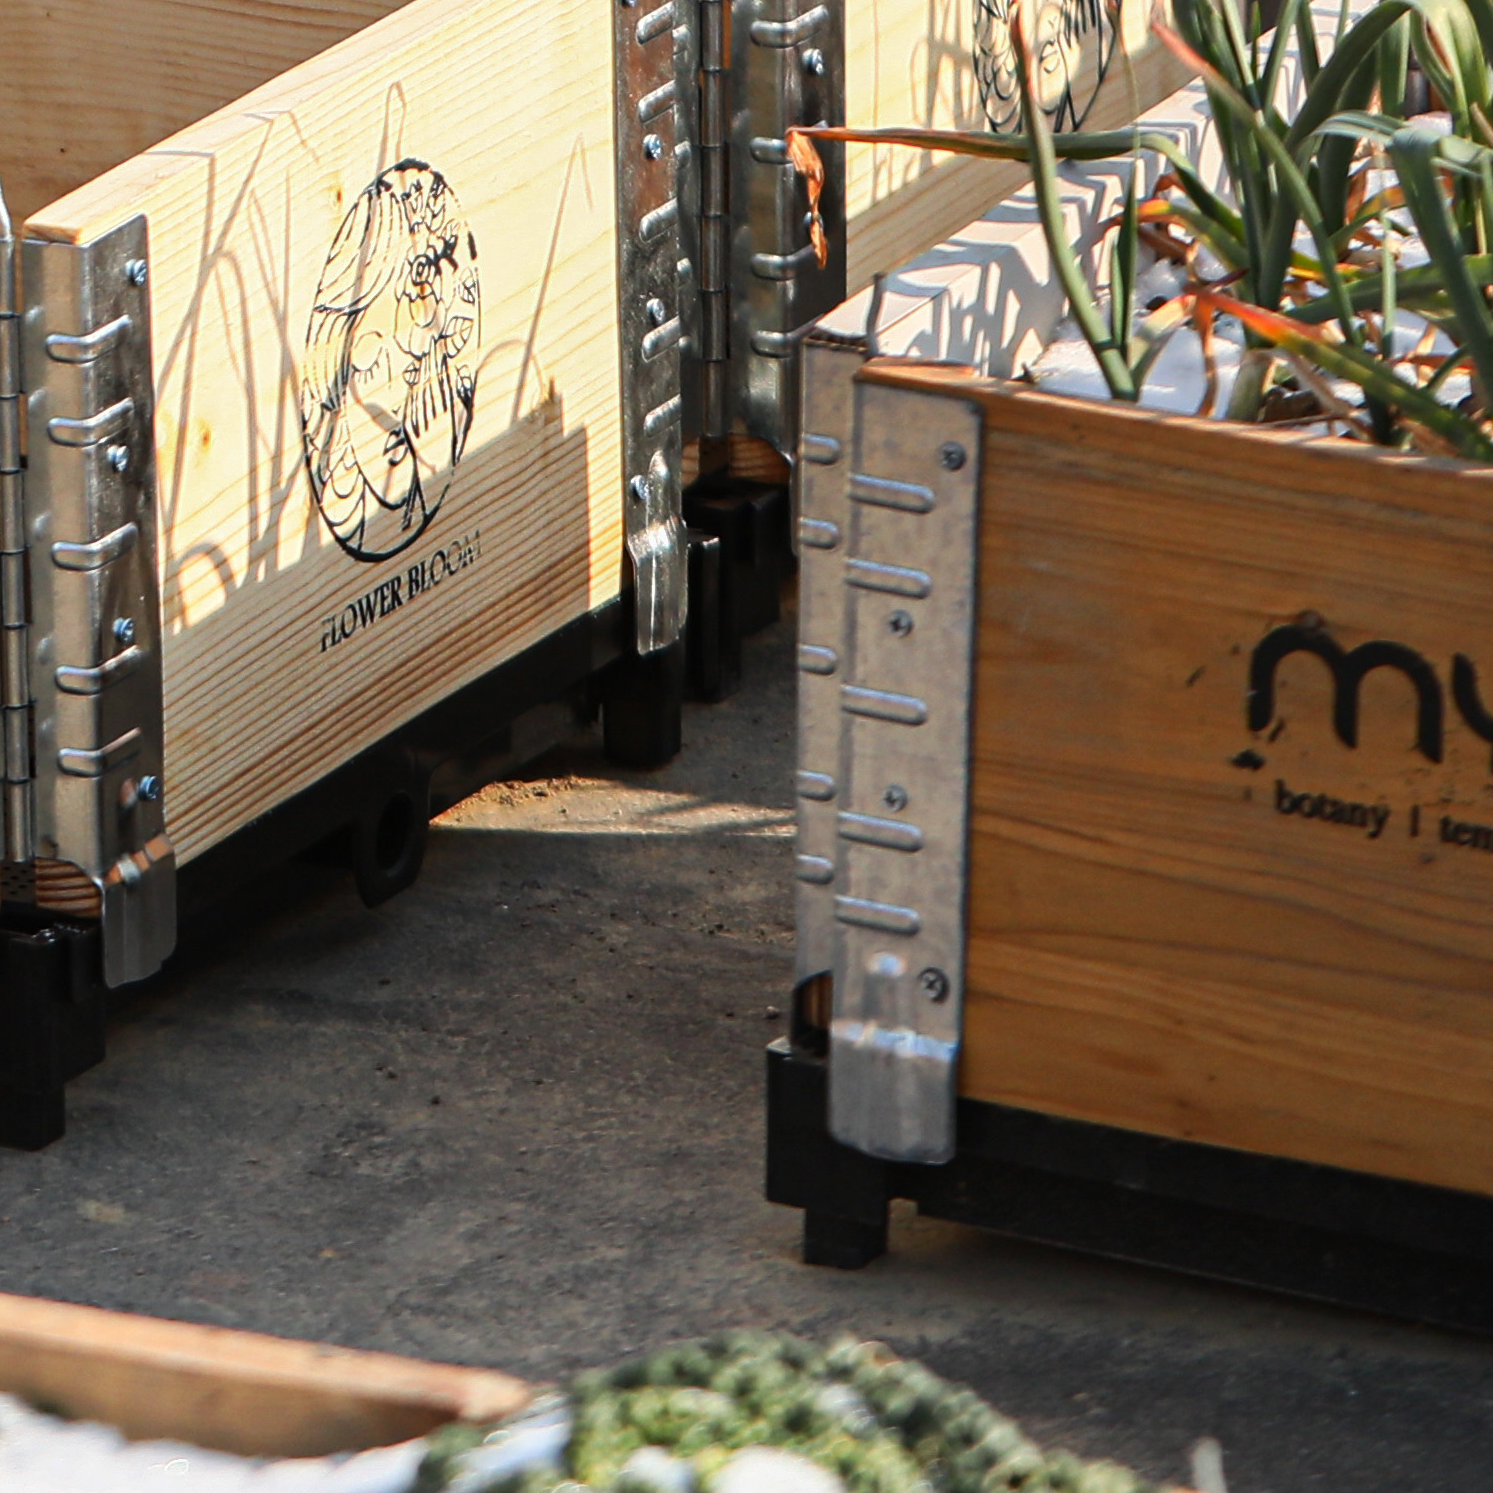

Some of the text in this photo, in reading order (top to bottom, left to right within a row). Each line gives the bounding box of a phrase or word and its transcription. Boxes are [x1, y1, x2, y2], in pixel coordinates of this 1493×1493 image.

[321, 530, 482, 652] FLOWER BLOOM
[1274, 778, 1391, 839] botany
